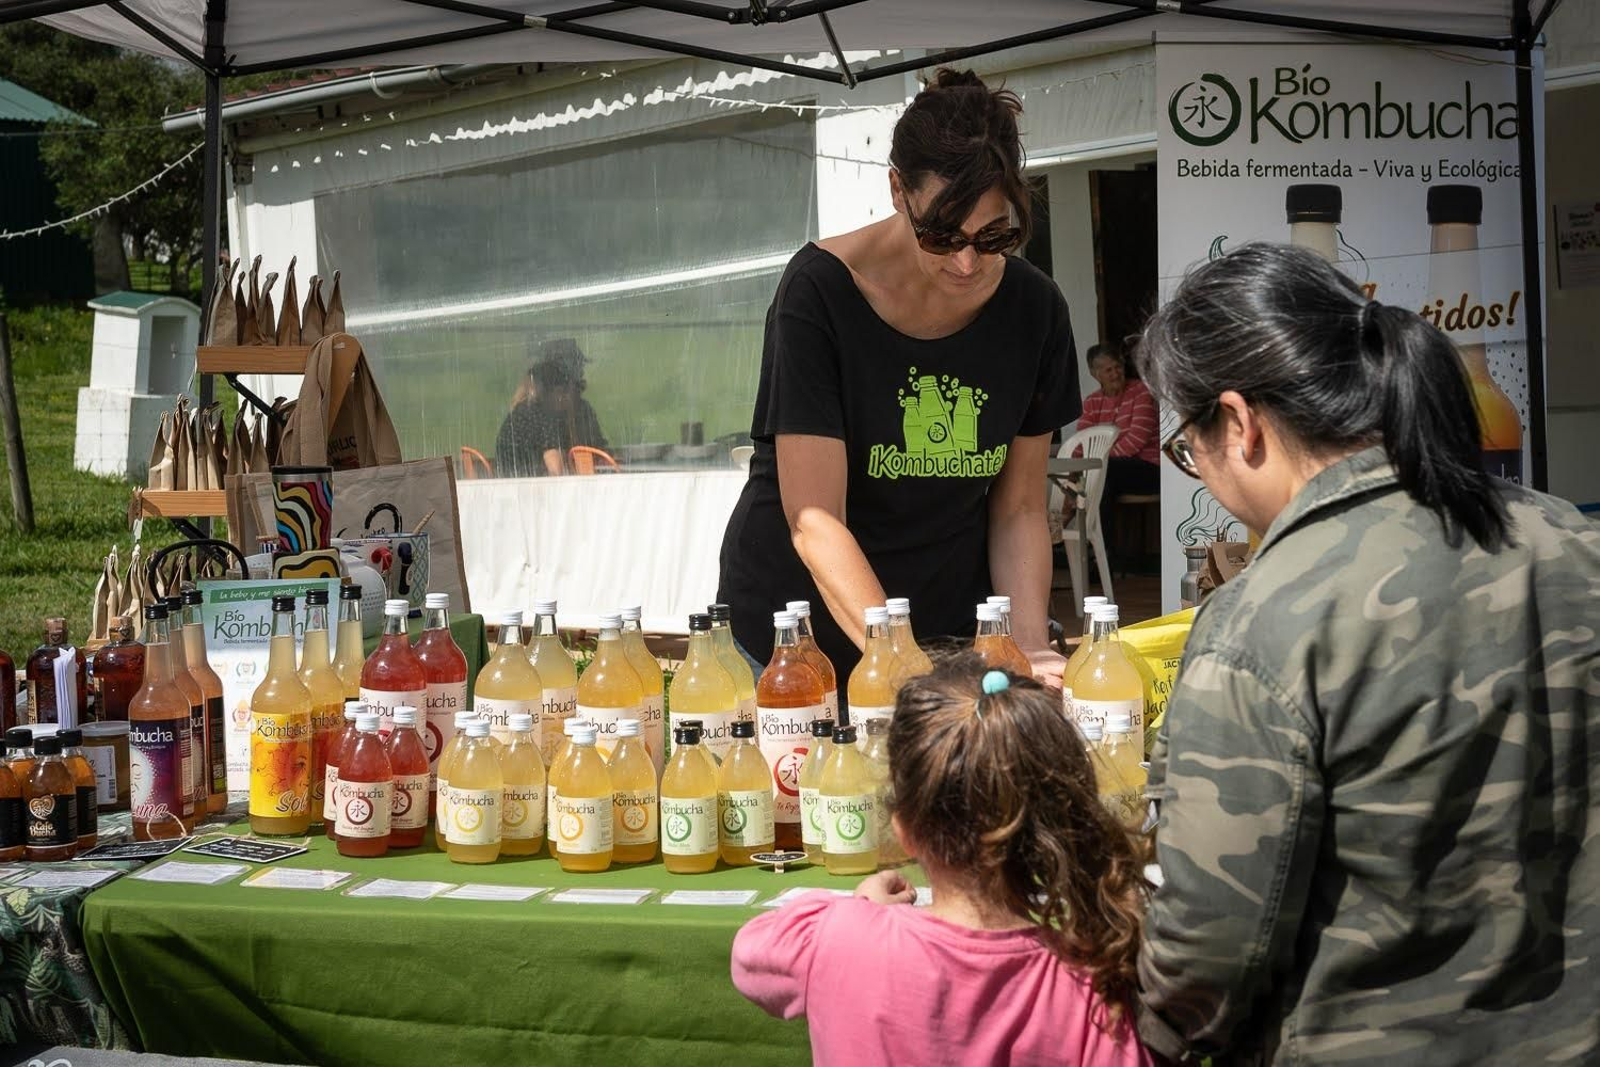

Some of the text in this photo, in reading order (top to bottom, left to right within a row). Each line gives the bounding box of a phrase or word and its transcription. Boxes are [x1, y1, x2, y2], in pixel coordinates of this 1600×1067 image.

[1274, 64, 1330, 96] Bío
[1249, 77, 1519, 145] Kombucha
[1177, 159, 1240, 178] Bebida
[1246, 159, 1352, 178] fermentada
[1373, 159, 1415, 178] Viva
[1421, 166, 1432, 182] y
[1439, 158, 1522, 183] Ecológica
[1420, 291, 1521, 332] tidos!
[129, 727, 174, 743] mbucha
[718, 796, 758, 808] ombucha
